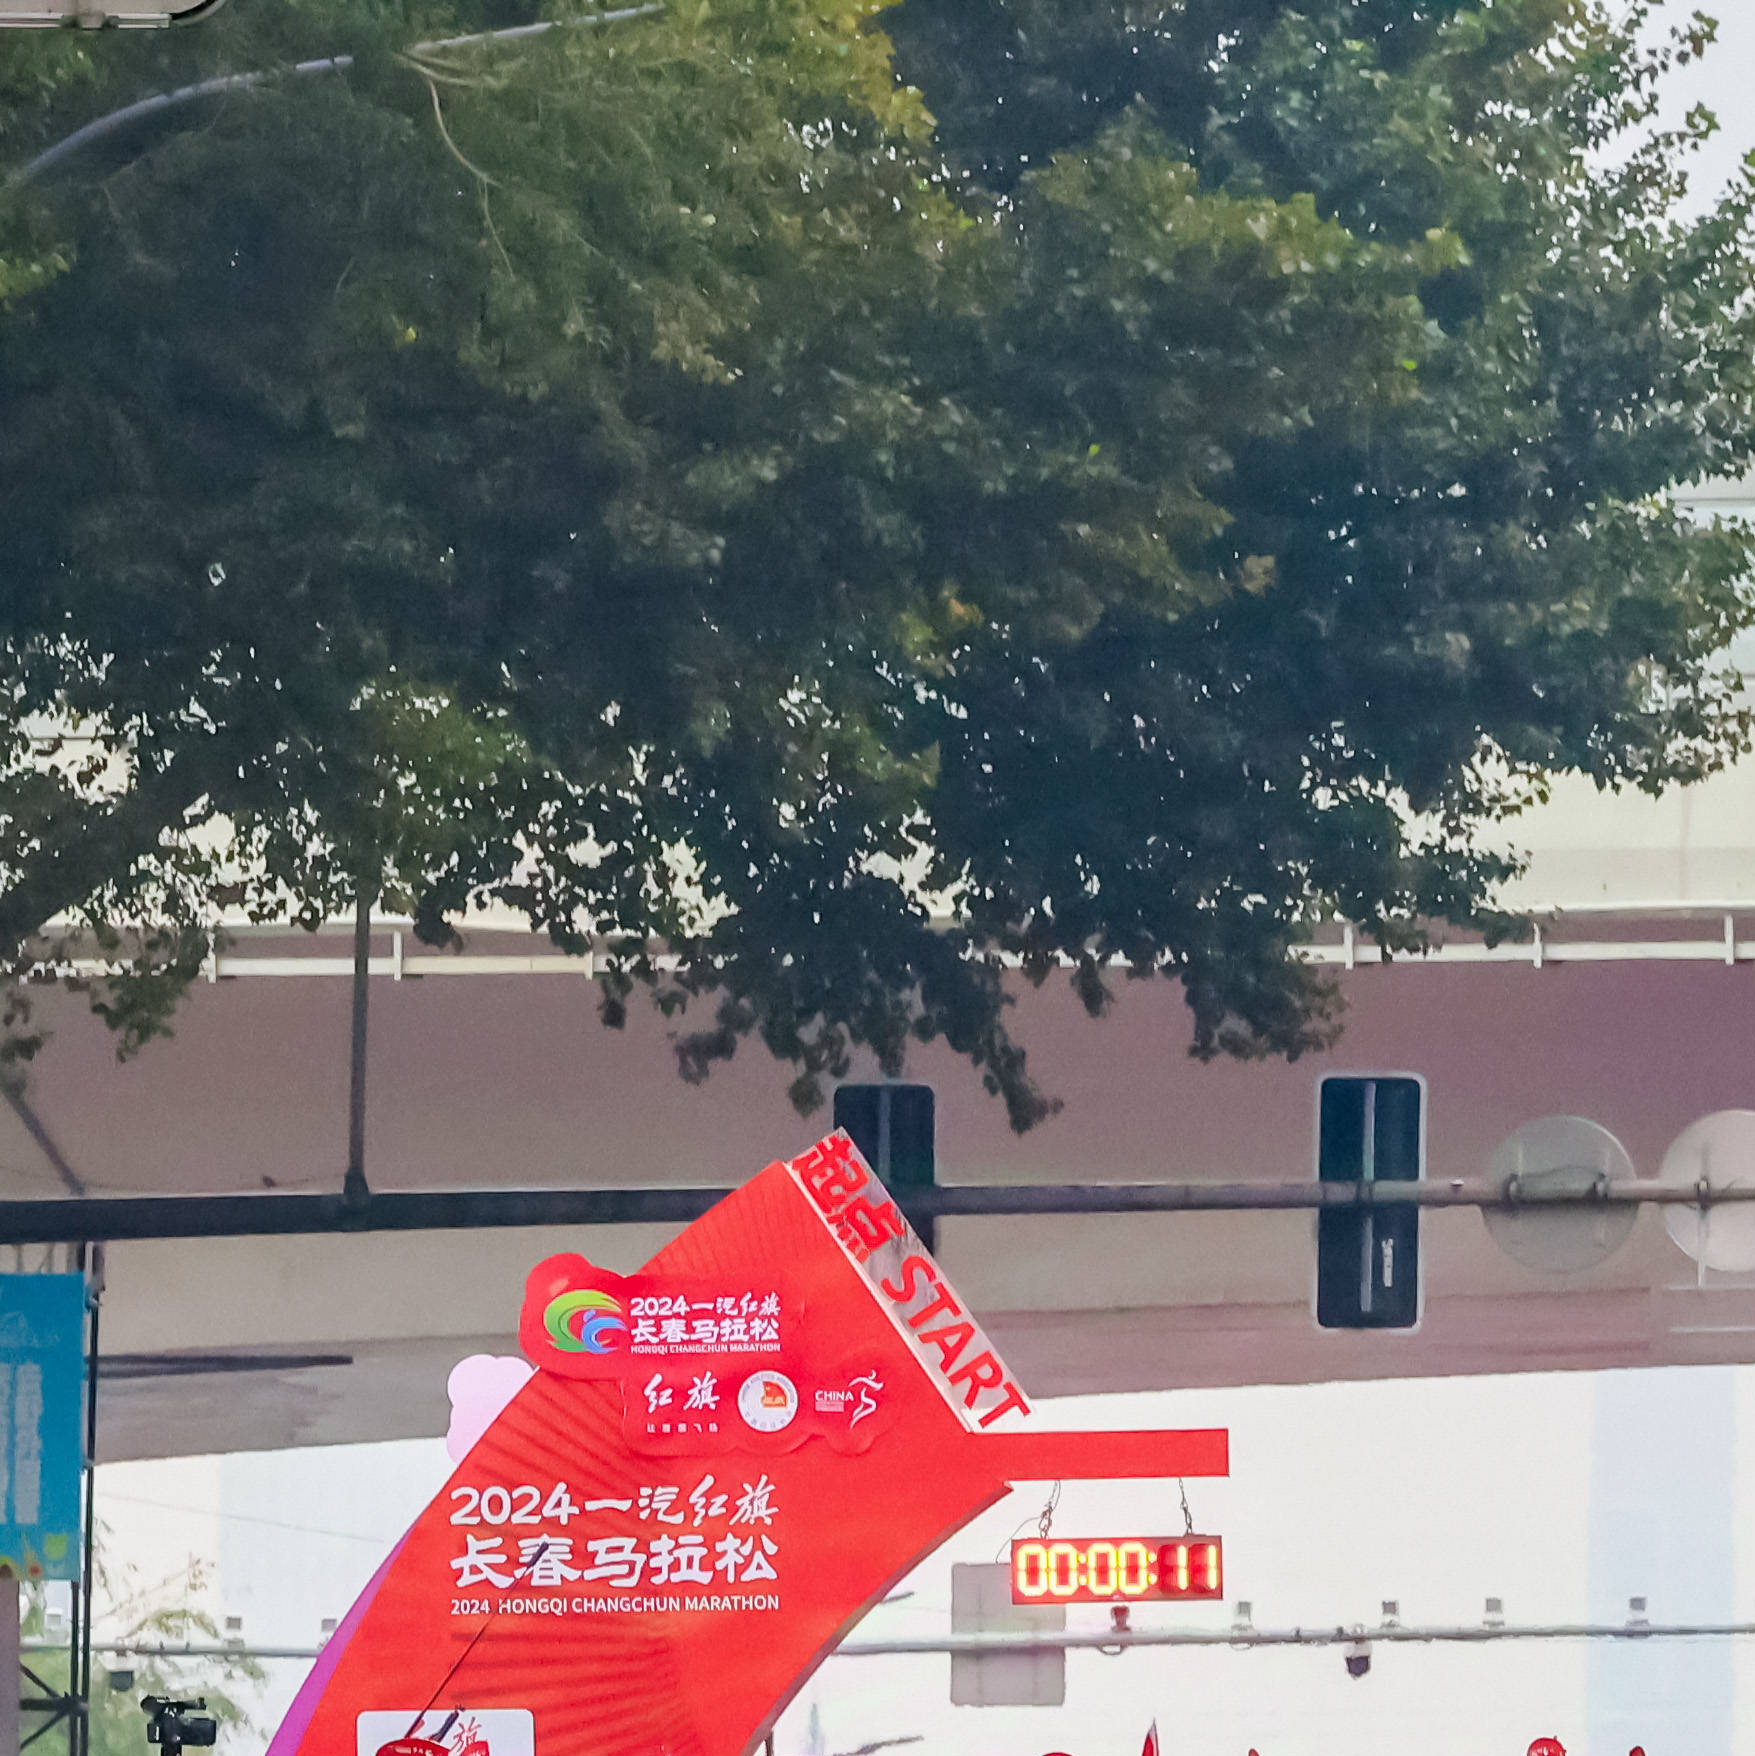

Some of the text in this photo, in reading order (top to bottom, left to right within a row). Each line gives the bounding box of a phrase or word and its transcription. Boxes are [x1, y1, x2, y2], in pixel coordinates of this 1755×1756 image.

[792, 1135, 905, 1262] 起点
[630, 1291, 781, 1318] 2024一汽红旗
[630, 1318, 780, 1343] 长春马拉松
[631, 1344, 668, 1355] HONGQI
[730, 1343, 781, 1353] MARATHON
[881, 1255, 1031, 1429] START
[643, 1370, 721, 1414] 红旗
[815, 1389, 854, 1402] CHINA
[450, 1473, 779, 1527] 2024一汽红旗
[450, 1533, 779, 1589] 长春马拉松
[1017, 1541, 1218, 1597] 00:00:11
[450, 1595, 779, 1616] 2024 HONGQI CHANGCHUN MARATHON
